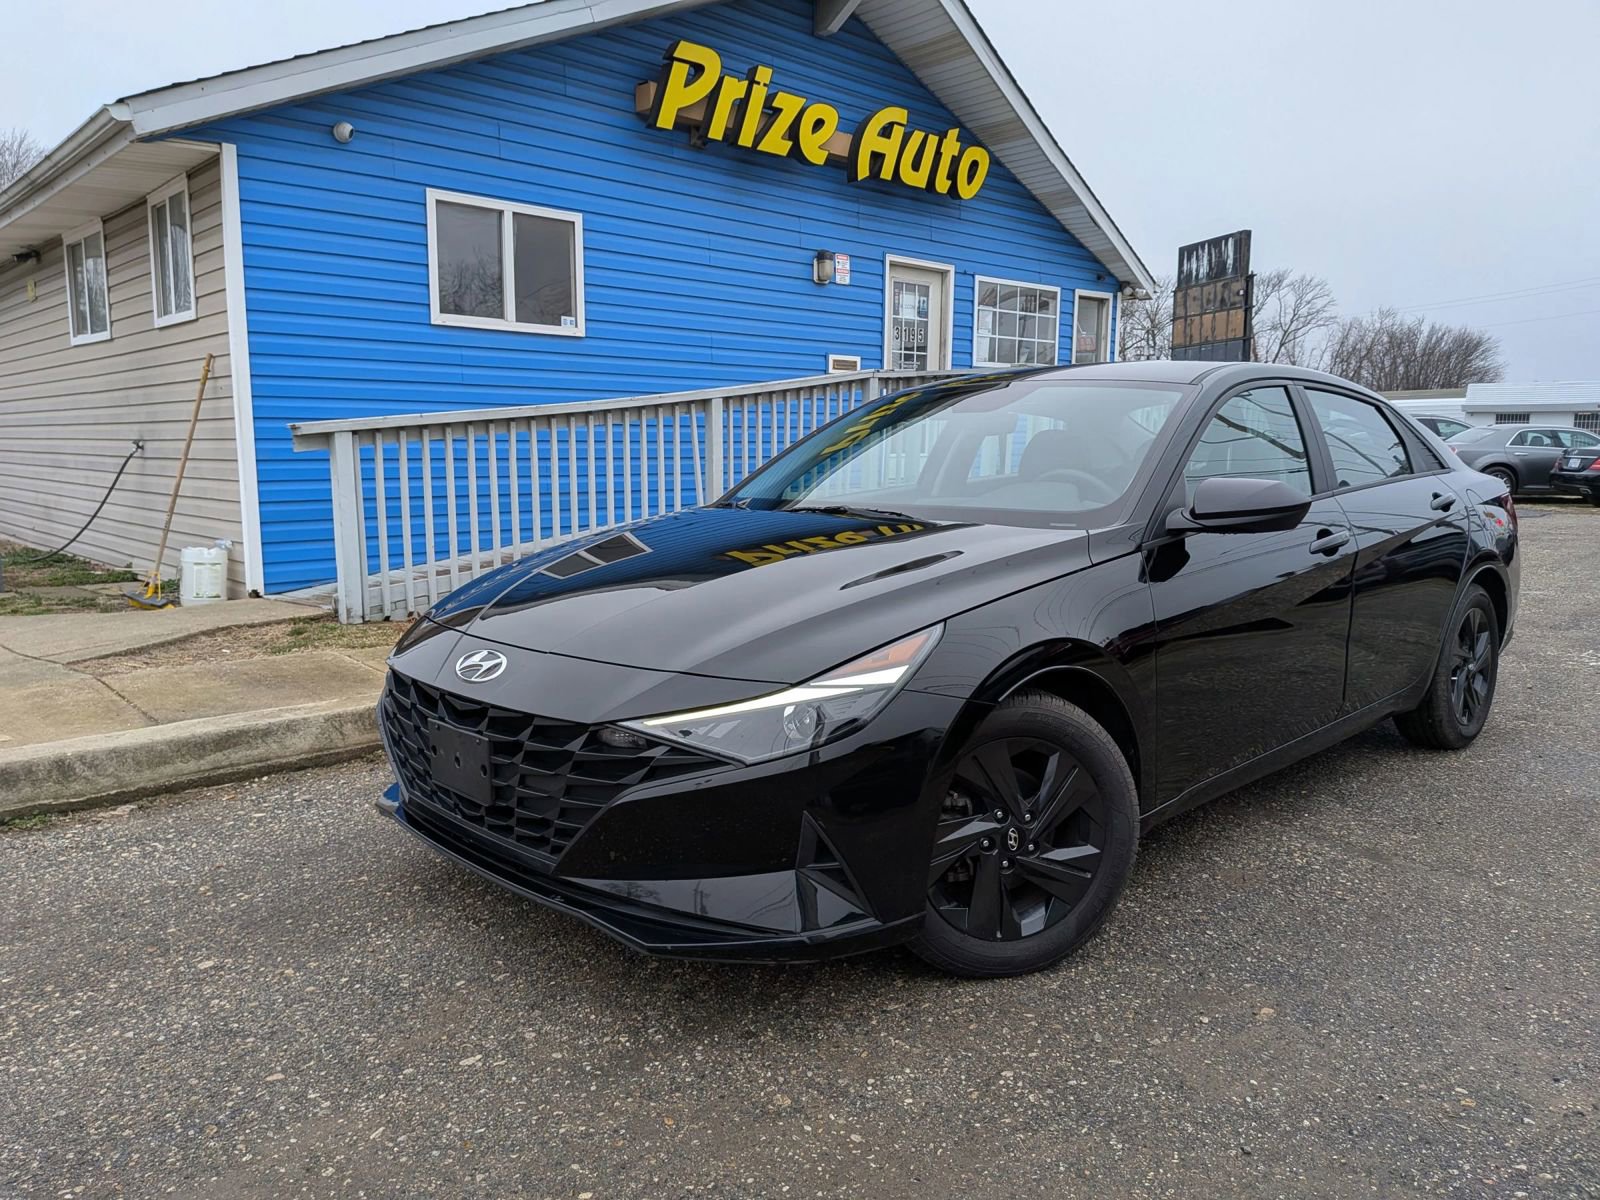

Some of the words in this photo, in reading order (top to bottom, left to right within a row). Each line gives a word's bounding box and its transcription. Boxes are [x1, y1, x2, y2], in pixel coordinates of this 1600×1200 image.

[656, 40, 840, 165] Prize
[857, 106, 990, 199] Auto
[895, 327, 924, 342] 3195
